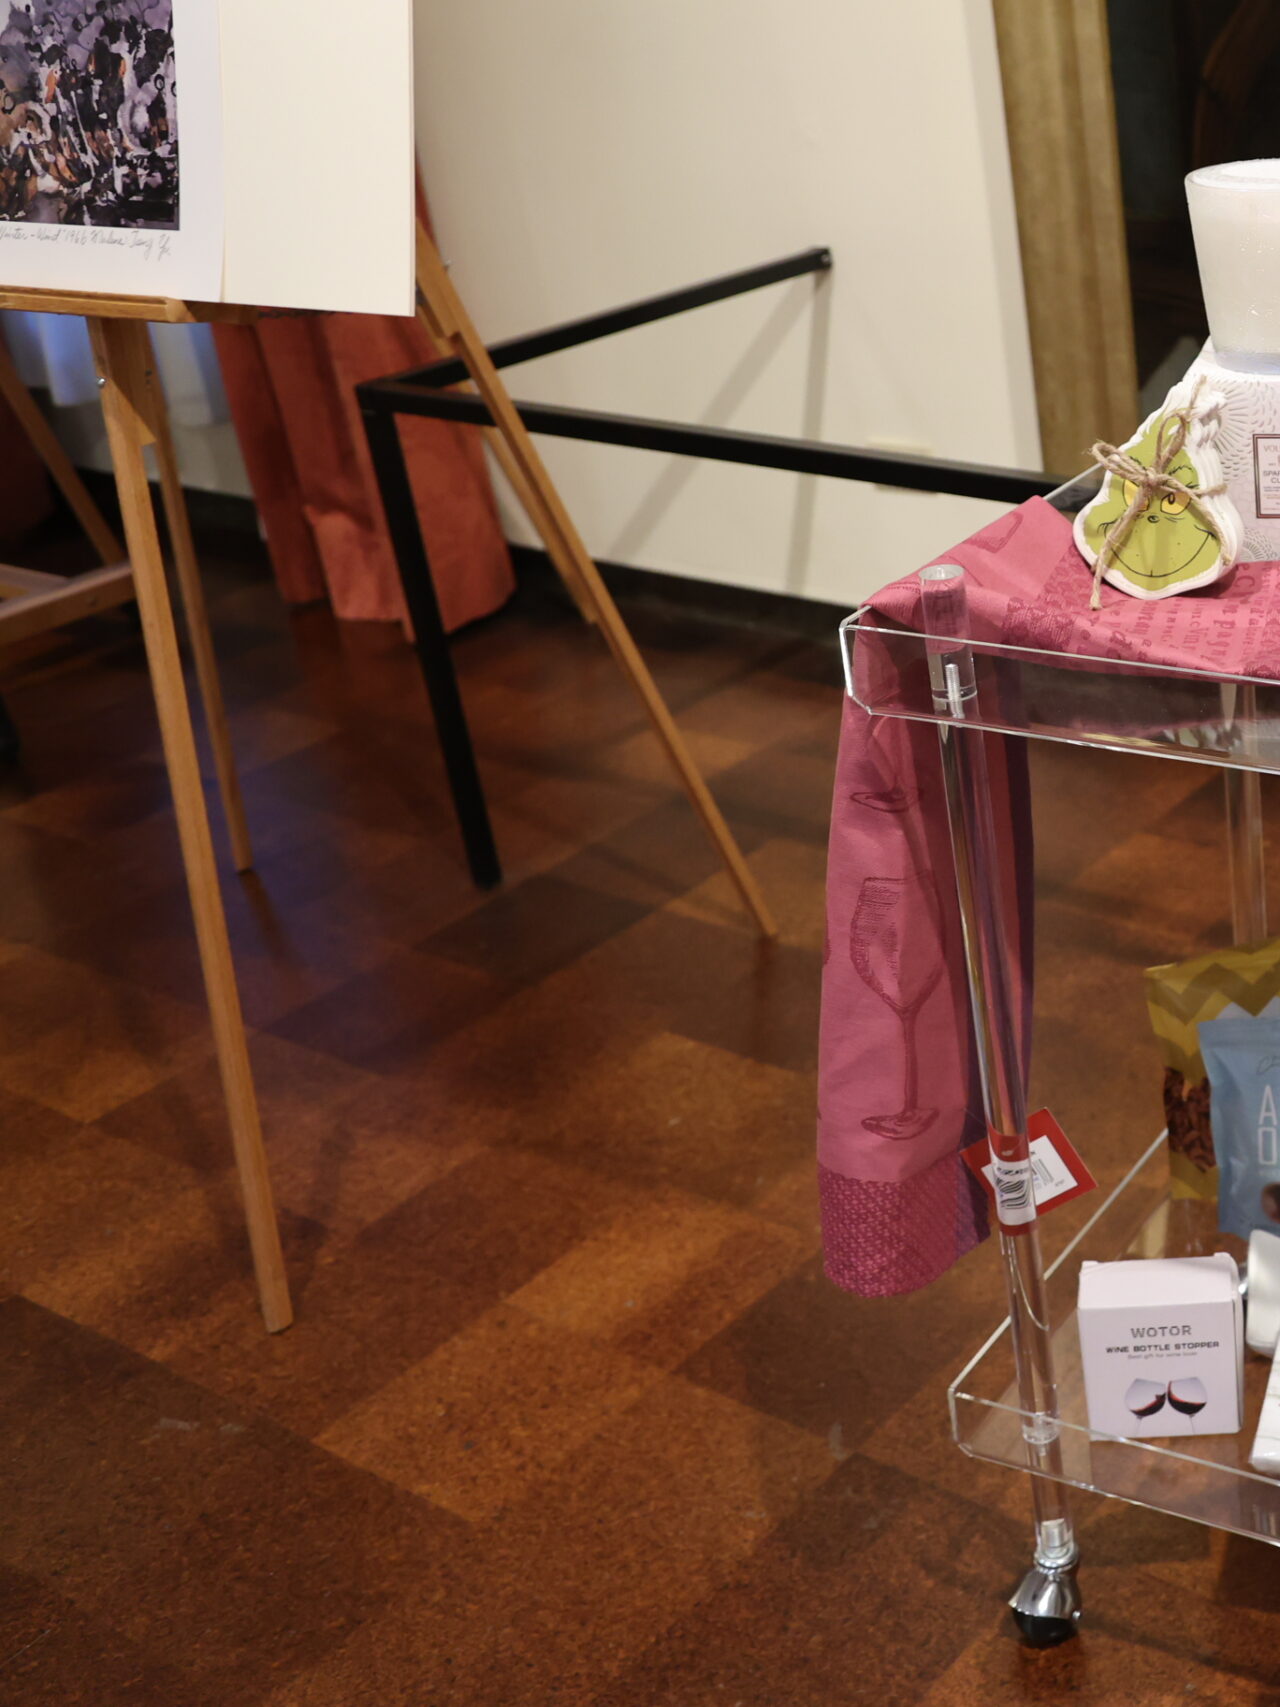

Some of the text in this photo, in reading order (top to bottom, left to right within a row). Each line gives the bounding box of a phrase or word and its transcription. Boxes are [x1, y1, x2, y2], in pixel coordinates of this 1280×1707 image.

[1130, 1325, 1192, 1339] WOTOR
[1105, 1341, 1220, 1354] WINE BOTTLE STOPPER
